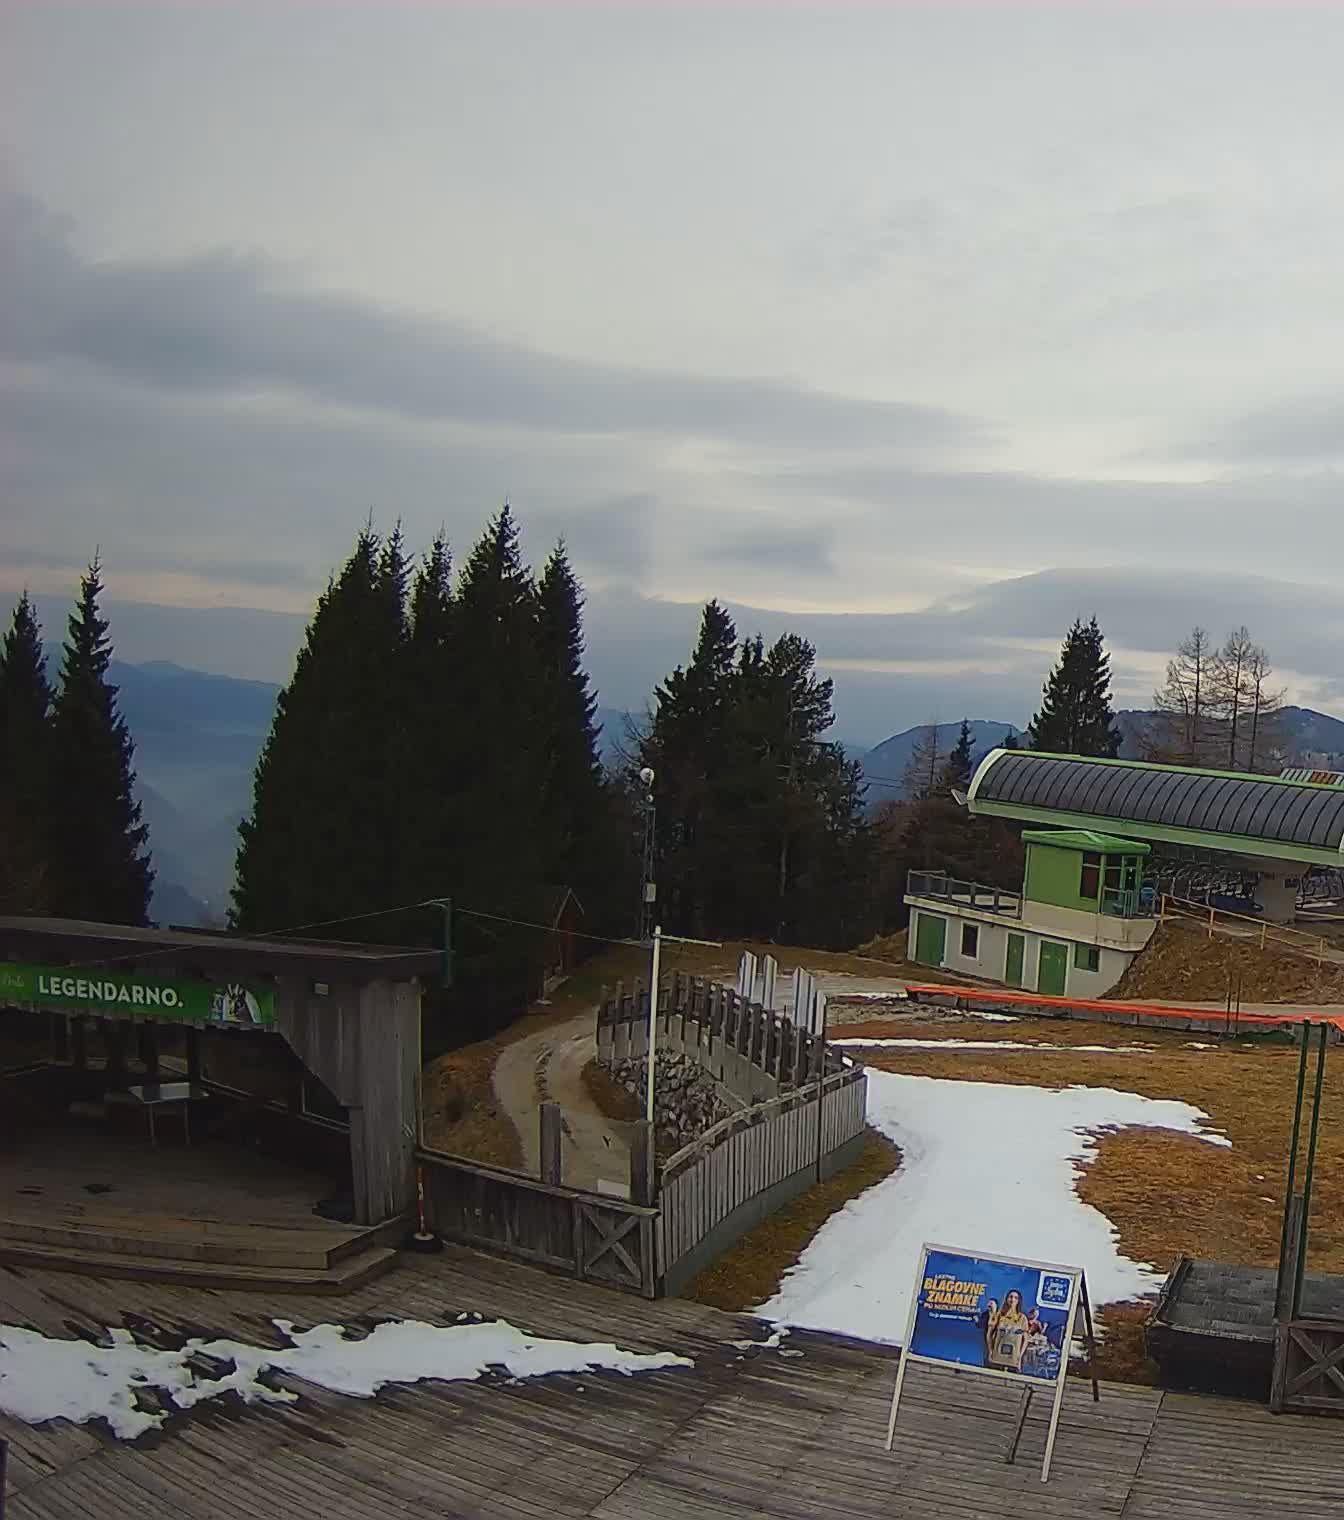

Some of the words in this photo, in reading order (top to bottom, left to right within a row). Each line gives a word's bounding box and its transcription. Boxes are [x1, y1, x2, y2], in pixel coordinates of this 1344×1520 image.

[38, 975, 185, 1008] LEGENDARNO.
[923, 1278, 987, 1296] BLAGOVNE
[926, 1291, 980, 1307] ZNAMKE
